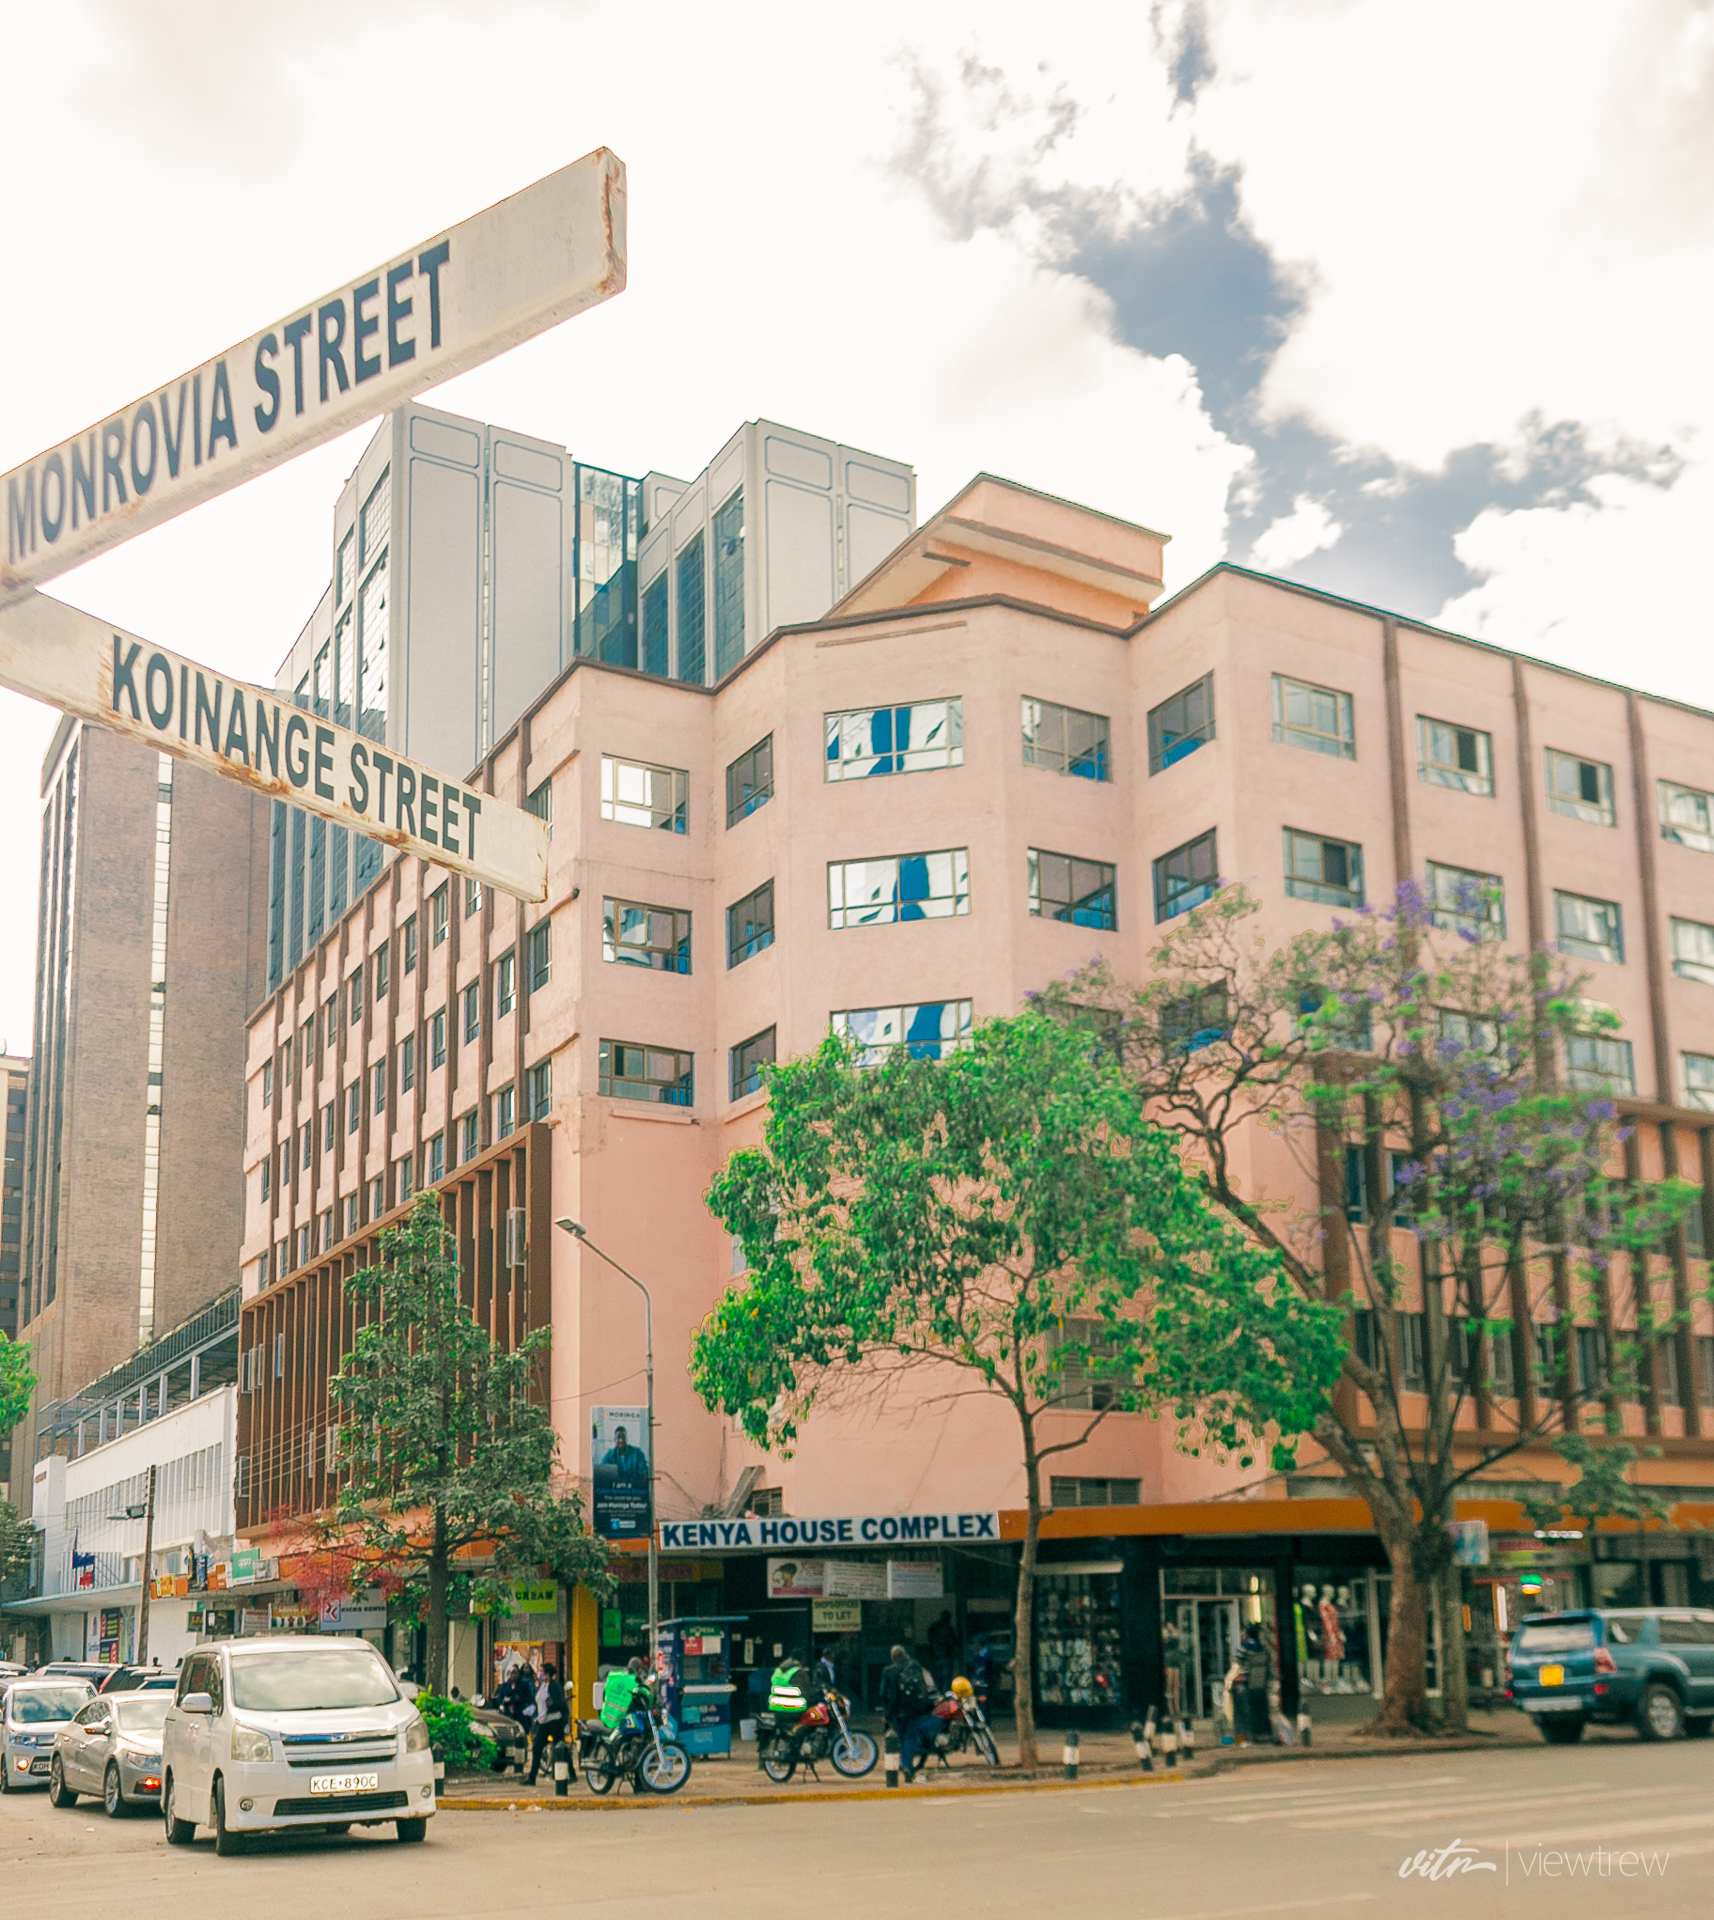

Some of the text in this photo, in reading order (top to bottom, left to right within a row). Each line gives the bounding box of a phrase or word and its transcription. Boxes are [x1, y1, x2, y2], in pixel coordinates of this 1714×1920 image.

[8, 239, 450, 565] MONROVIA STREET
[112, 634, 482, 861] KOINANGE STREET
[609, 1411, 640, 1419] MORINGA
[662, 1513, 995, 1547] KENYA HOUSE COMPLEX
[822, 1611, 851, 1621] TO LET
